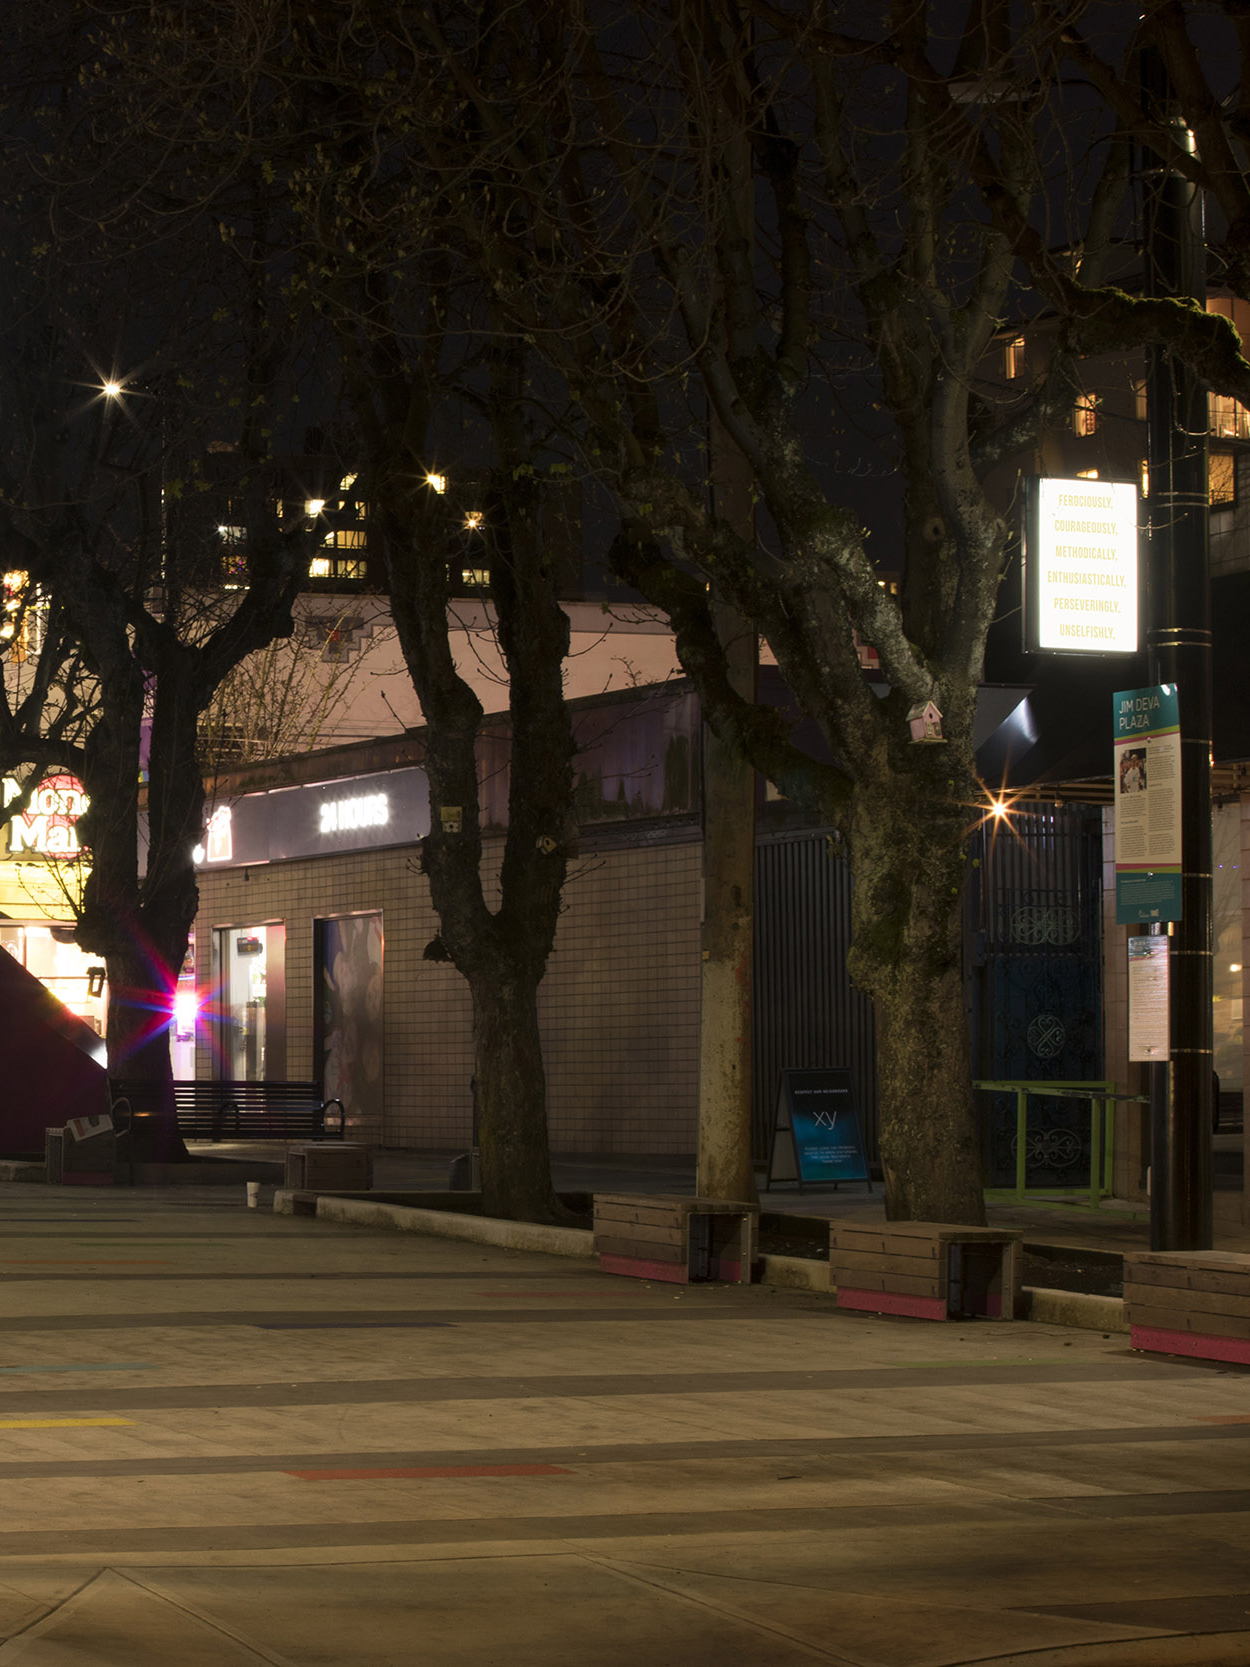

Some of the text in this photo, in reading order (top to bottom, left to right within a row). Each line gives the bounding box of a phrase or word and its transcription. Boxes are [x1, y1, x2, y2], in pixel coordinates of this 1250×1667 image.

[1058, 494, 1114, 510] FEROCIOUSLY,
[1054, 520, 1118, 536] COURAGEOUSLY,
[1055, 545, 1118, 561] METHODICALLY,
[1047, 571, 1127, 588] ENTHUSIASTICALLY,
[1054, 597, 1121, 614] PERSEVERINGLY,
[1059, 623, 1116, 640] UNSELFISHLY,
[1119, 695, 1160, 714] JIM DEVA
[1119, 714, 1150, 730] PLAZA
[320, 793, 389, 833] 24 HOURS
[813, 1111, 837, 1131] xy
